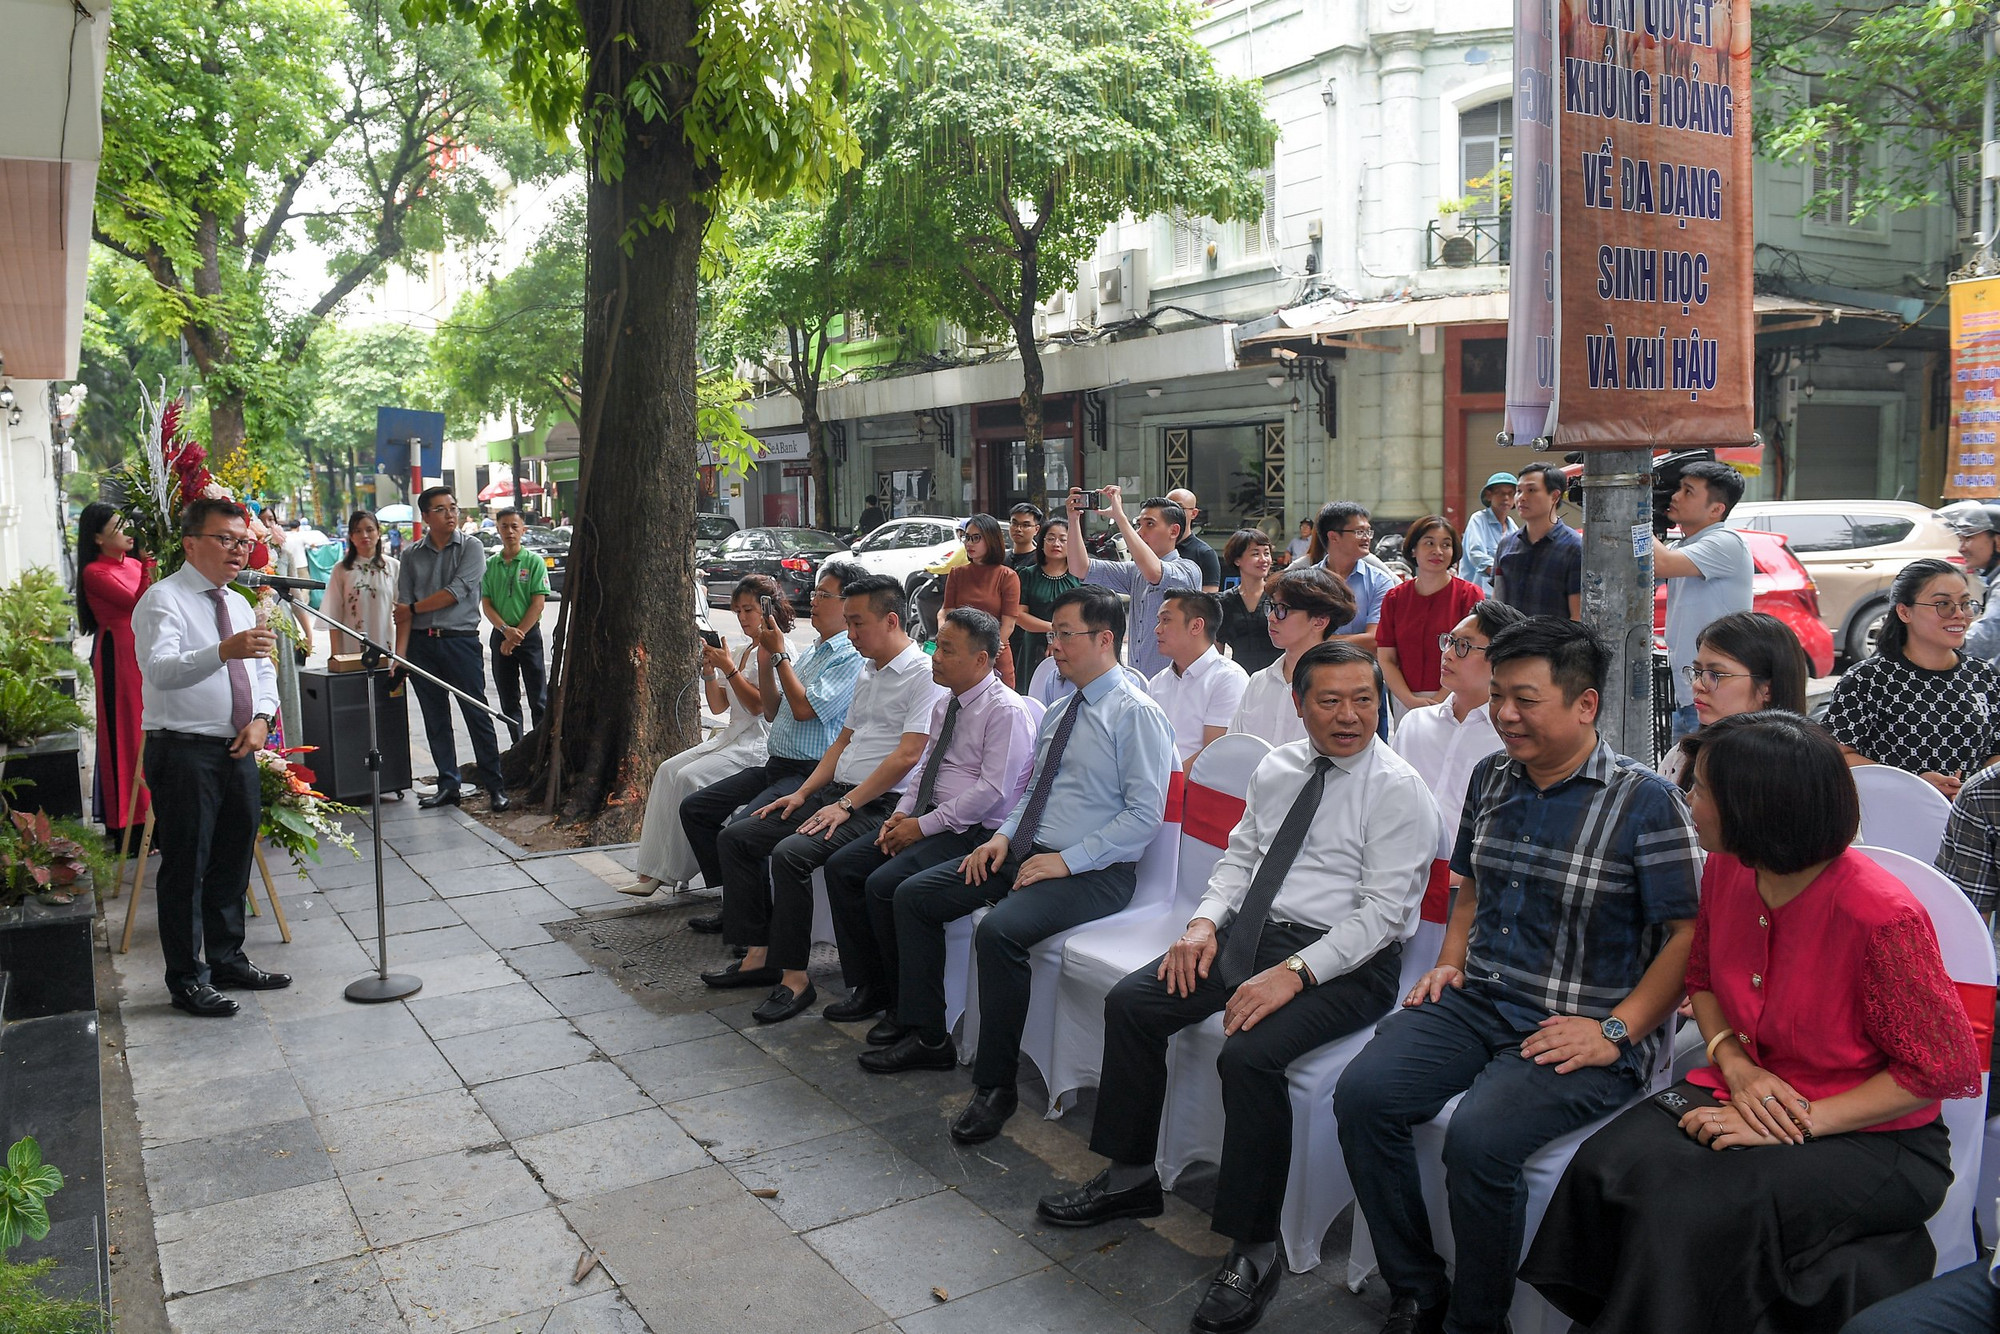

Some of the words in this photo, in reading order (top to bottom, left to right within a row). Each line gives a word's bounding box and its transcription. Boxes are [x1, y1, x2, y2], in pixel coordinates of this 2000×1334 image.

[1565, 45, 1652, 124] KHỦNG
[1659, 61, 1734, 138] HOẢNG
[1582, 136, 1613, 209] VỀ
[1620, 156, 1655, 213] ĐA
[1659, 162, 1722, 229] DẠNG
[1597, 245, 1657, 302] SINH
[1662, 250, 1709, 316] HỌC
[1586, 323, 1620, 389] VÀ
[1626, 326, 1667, 390] KHÍ
[1672, 328, 1718, 401] HẬU
[767, 440, 798, 454] SeABank
